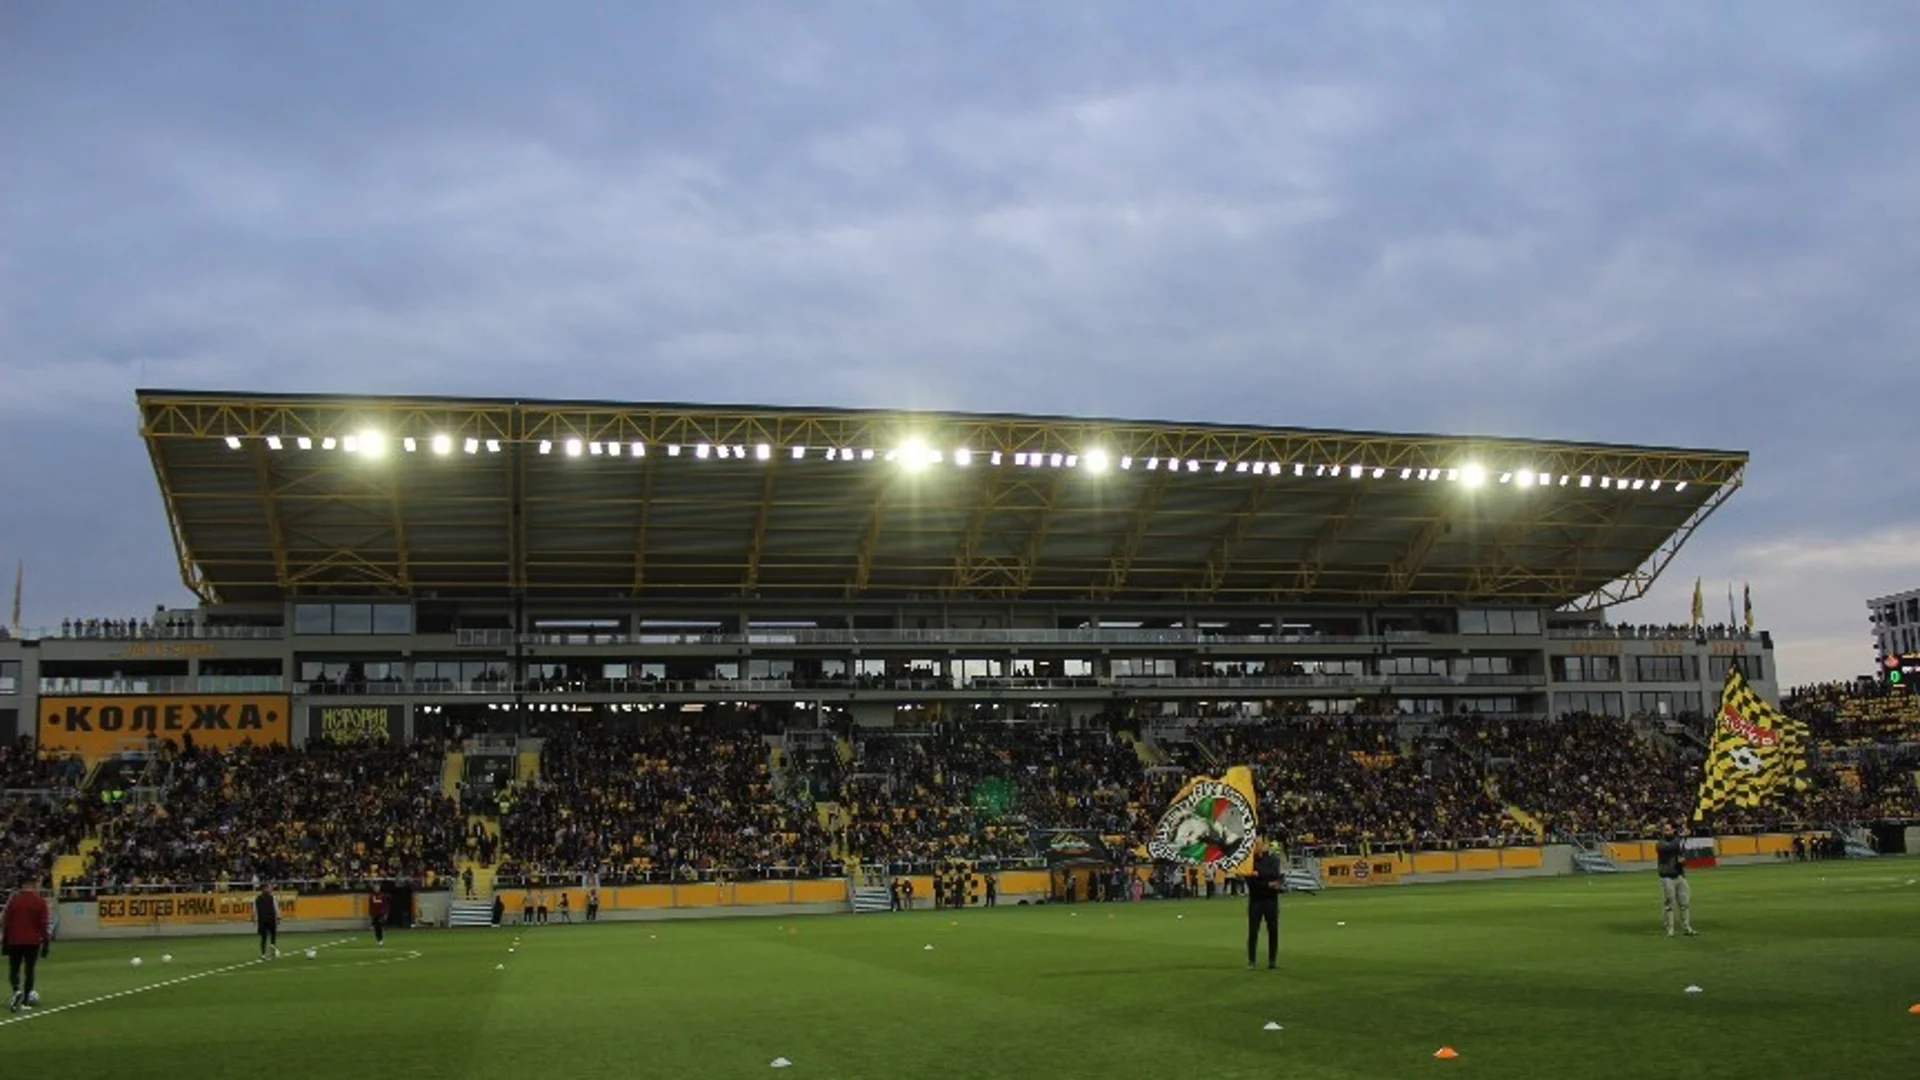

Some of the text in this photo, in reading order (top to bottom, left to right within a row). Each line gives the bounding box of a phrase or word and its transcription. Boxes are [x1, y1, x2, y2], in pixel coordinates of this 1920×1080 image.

[65, 703, 264, 732] КОЛЕЖА
[100, 899, 125, 918] БЕЗ
[129, 899, 173, 917] БОТЕВ
[177, 898, 217, 916] НЯМА
